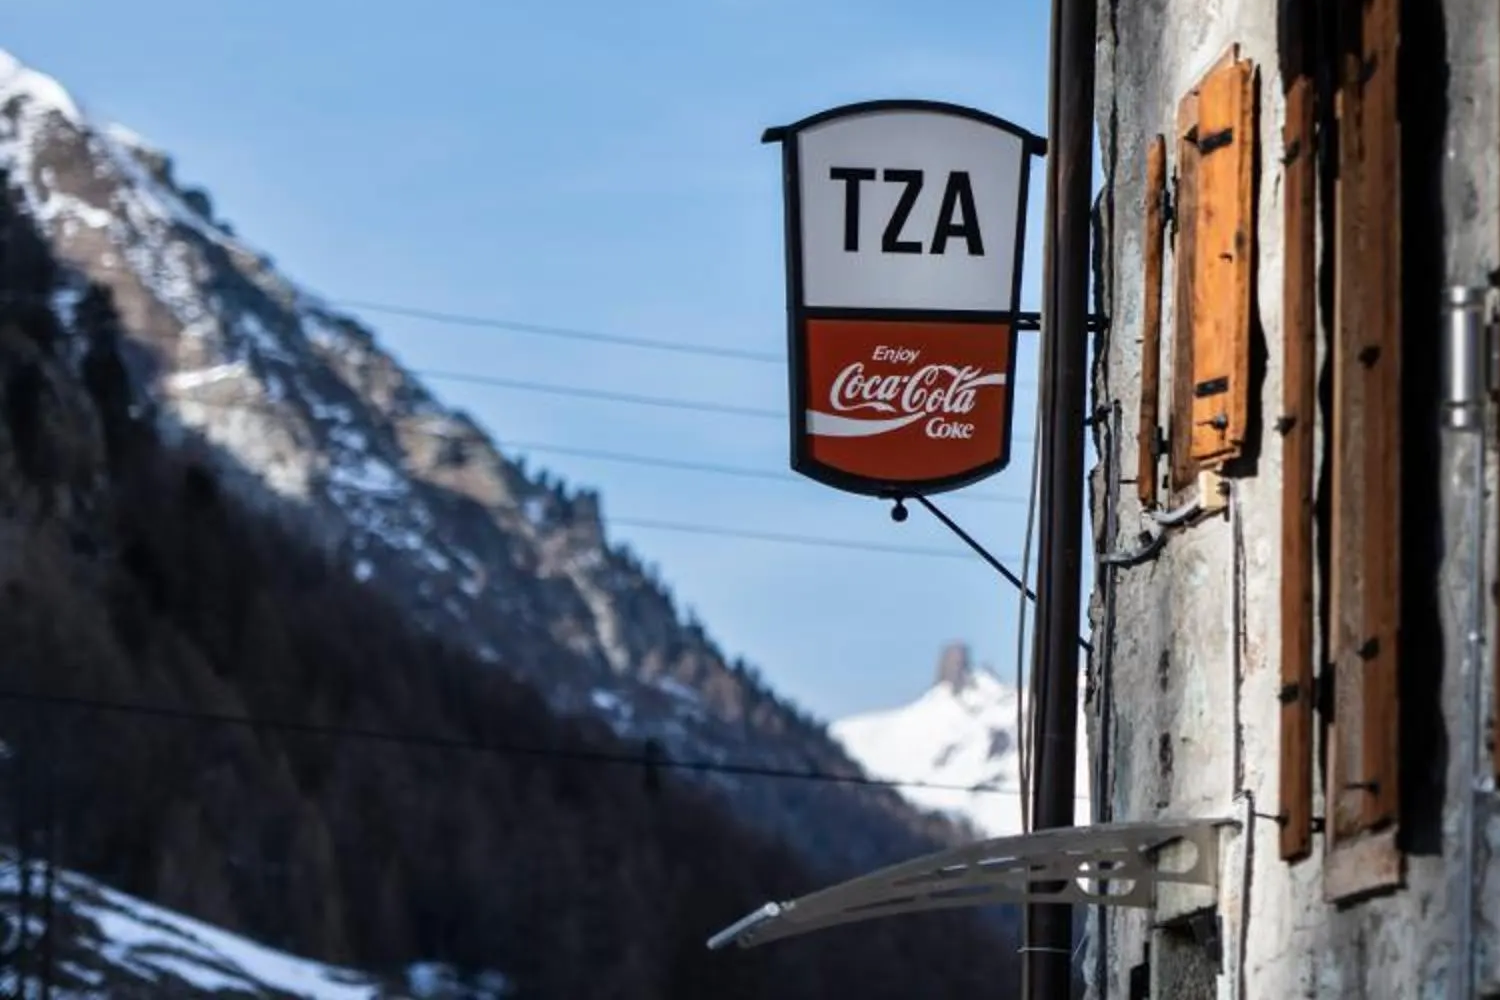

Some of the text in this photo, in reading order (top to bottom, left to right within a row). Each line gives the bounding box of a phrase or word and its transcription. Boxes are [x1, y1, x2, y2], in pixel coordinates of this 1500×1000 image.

[830, 167, 985, 257] TZA
[872, 345, 920, 364] Enjoy
[829, 362, 981, 414] Coca-Cola
[925, 417, 975, 439] Coke
